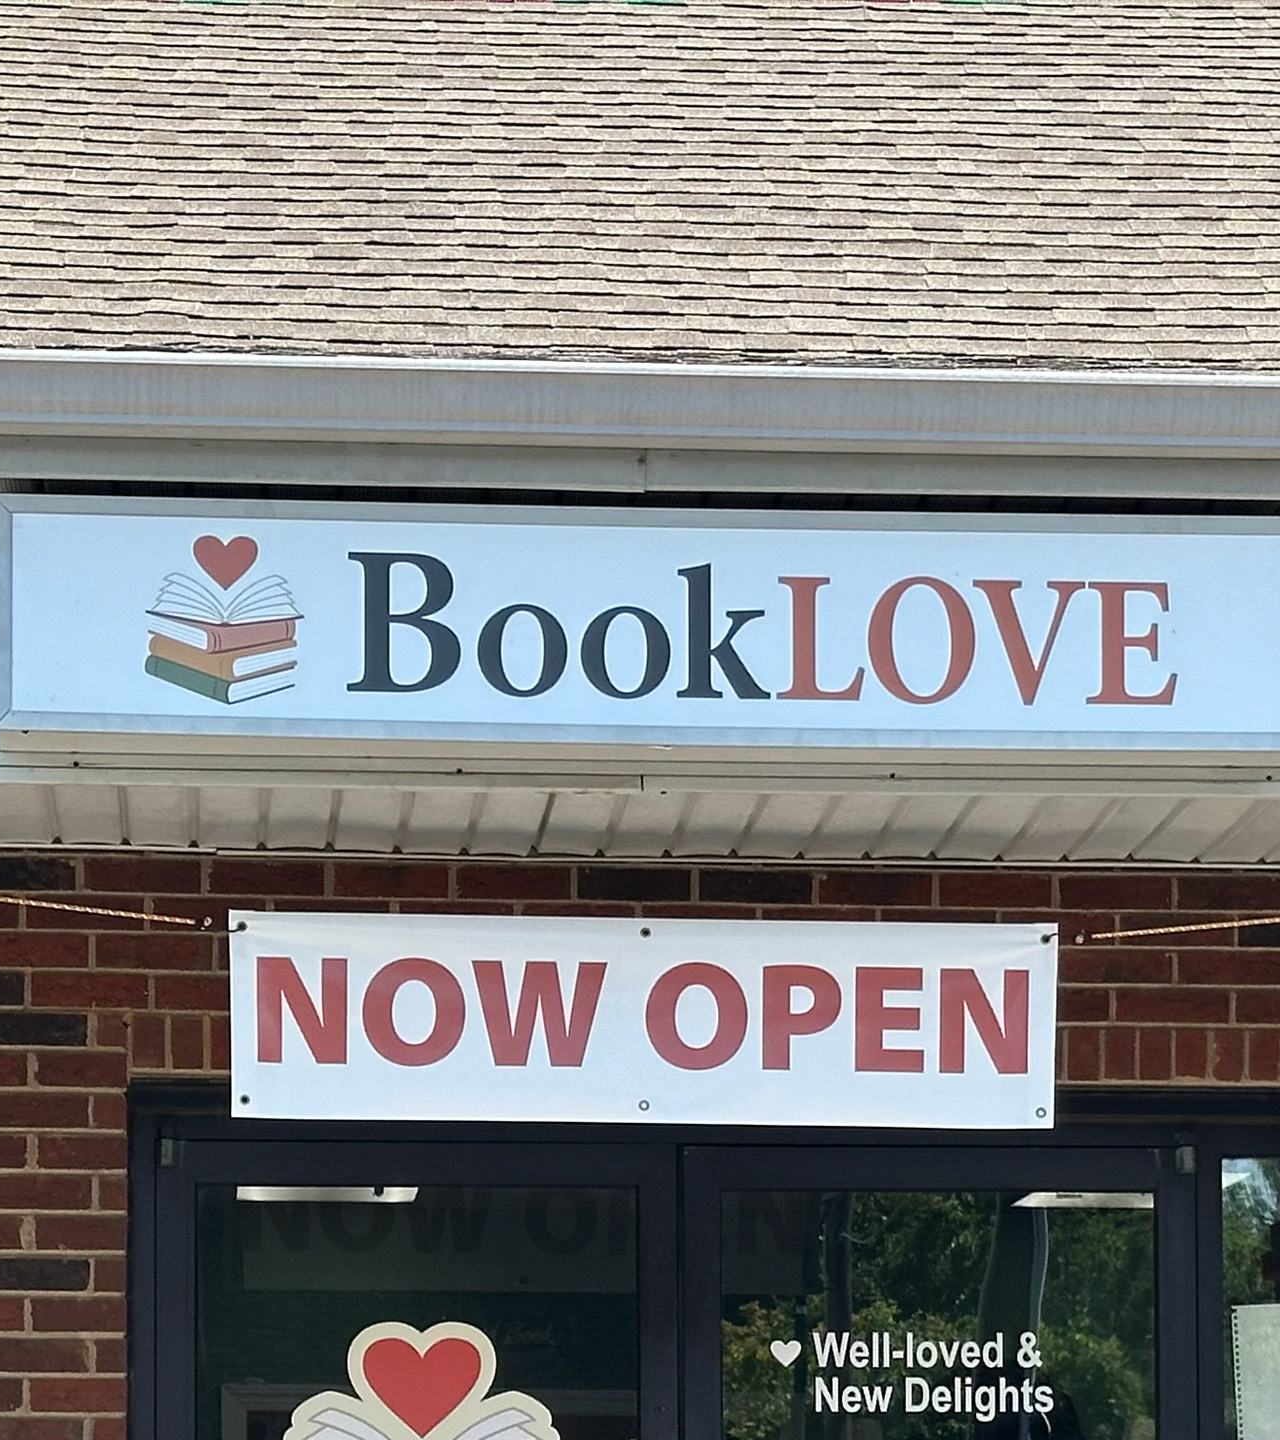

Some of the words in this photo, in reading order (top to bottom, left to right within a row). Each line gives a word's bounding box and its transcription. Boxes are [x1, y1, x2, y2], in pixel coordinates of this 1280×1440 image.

[347, 550, 1178, 706] BookLOVE
[255, 956, 608, 1068] NOW
[644, 961, 1030, 1076] OPEN
[812, 1332, 1004, 1368] Well-loved
[1016, 1332, 1043, 1368] &
[815, 1377, 894, 1413] New
[905, 1377, 1055, 1422] Delights
